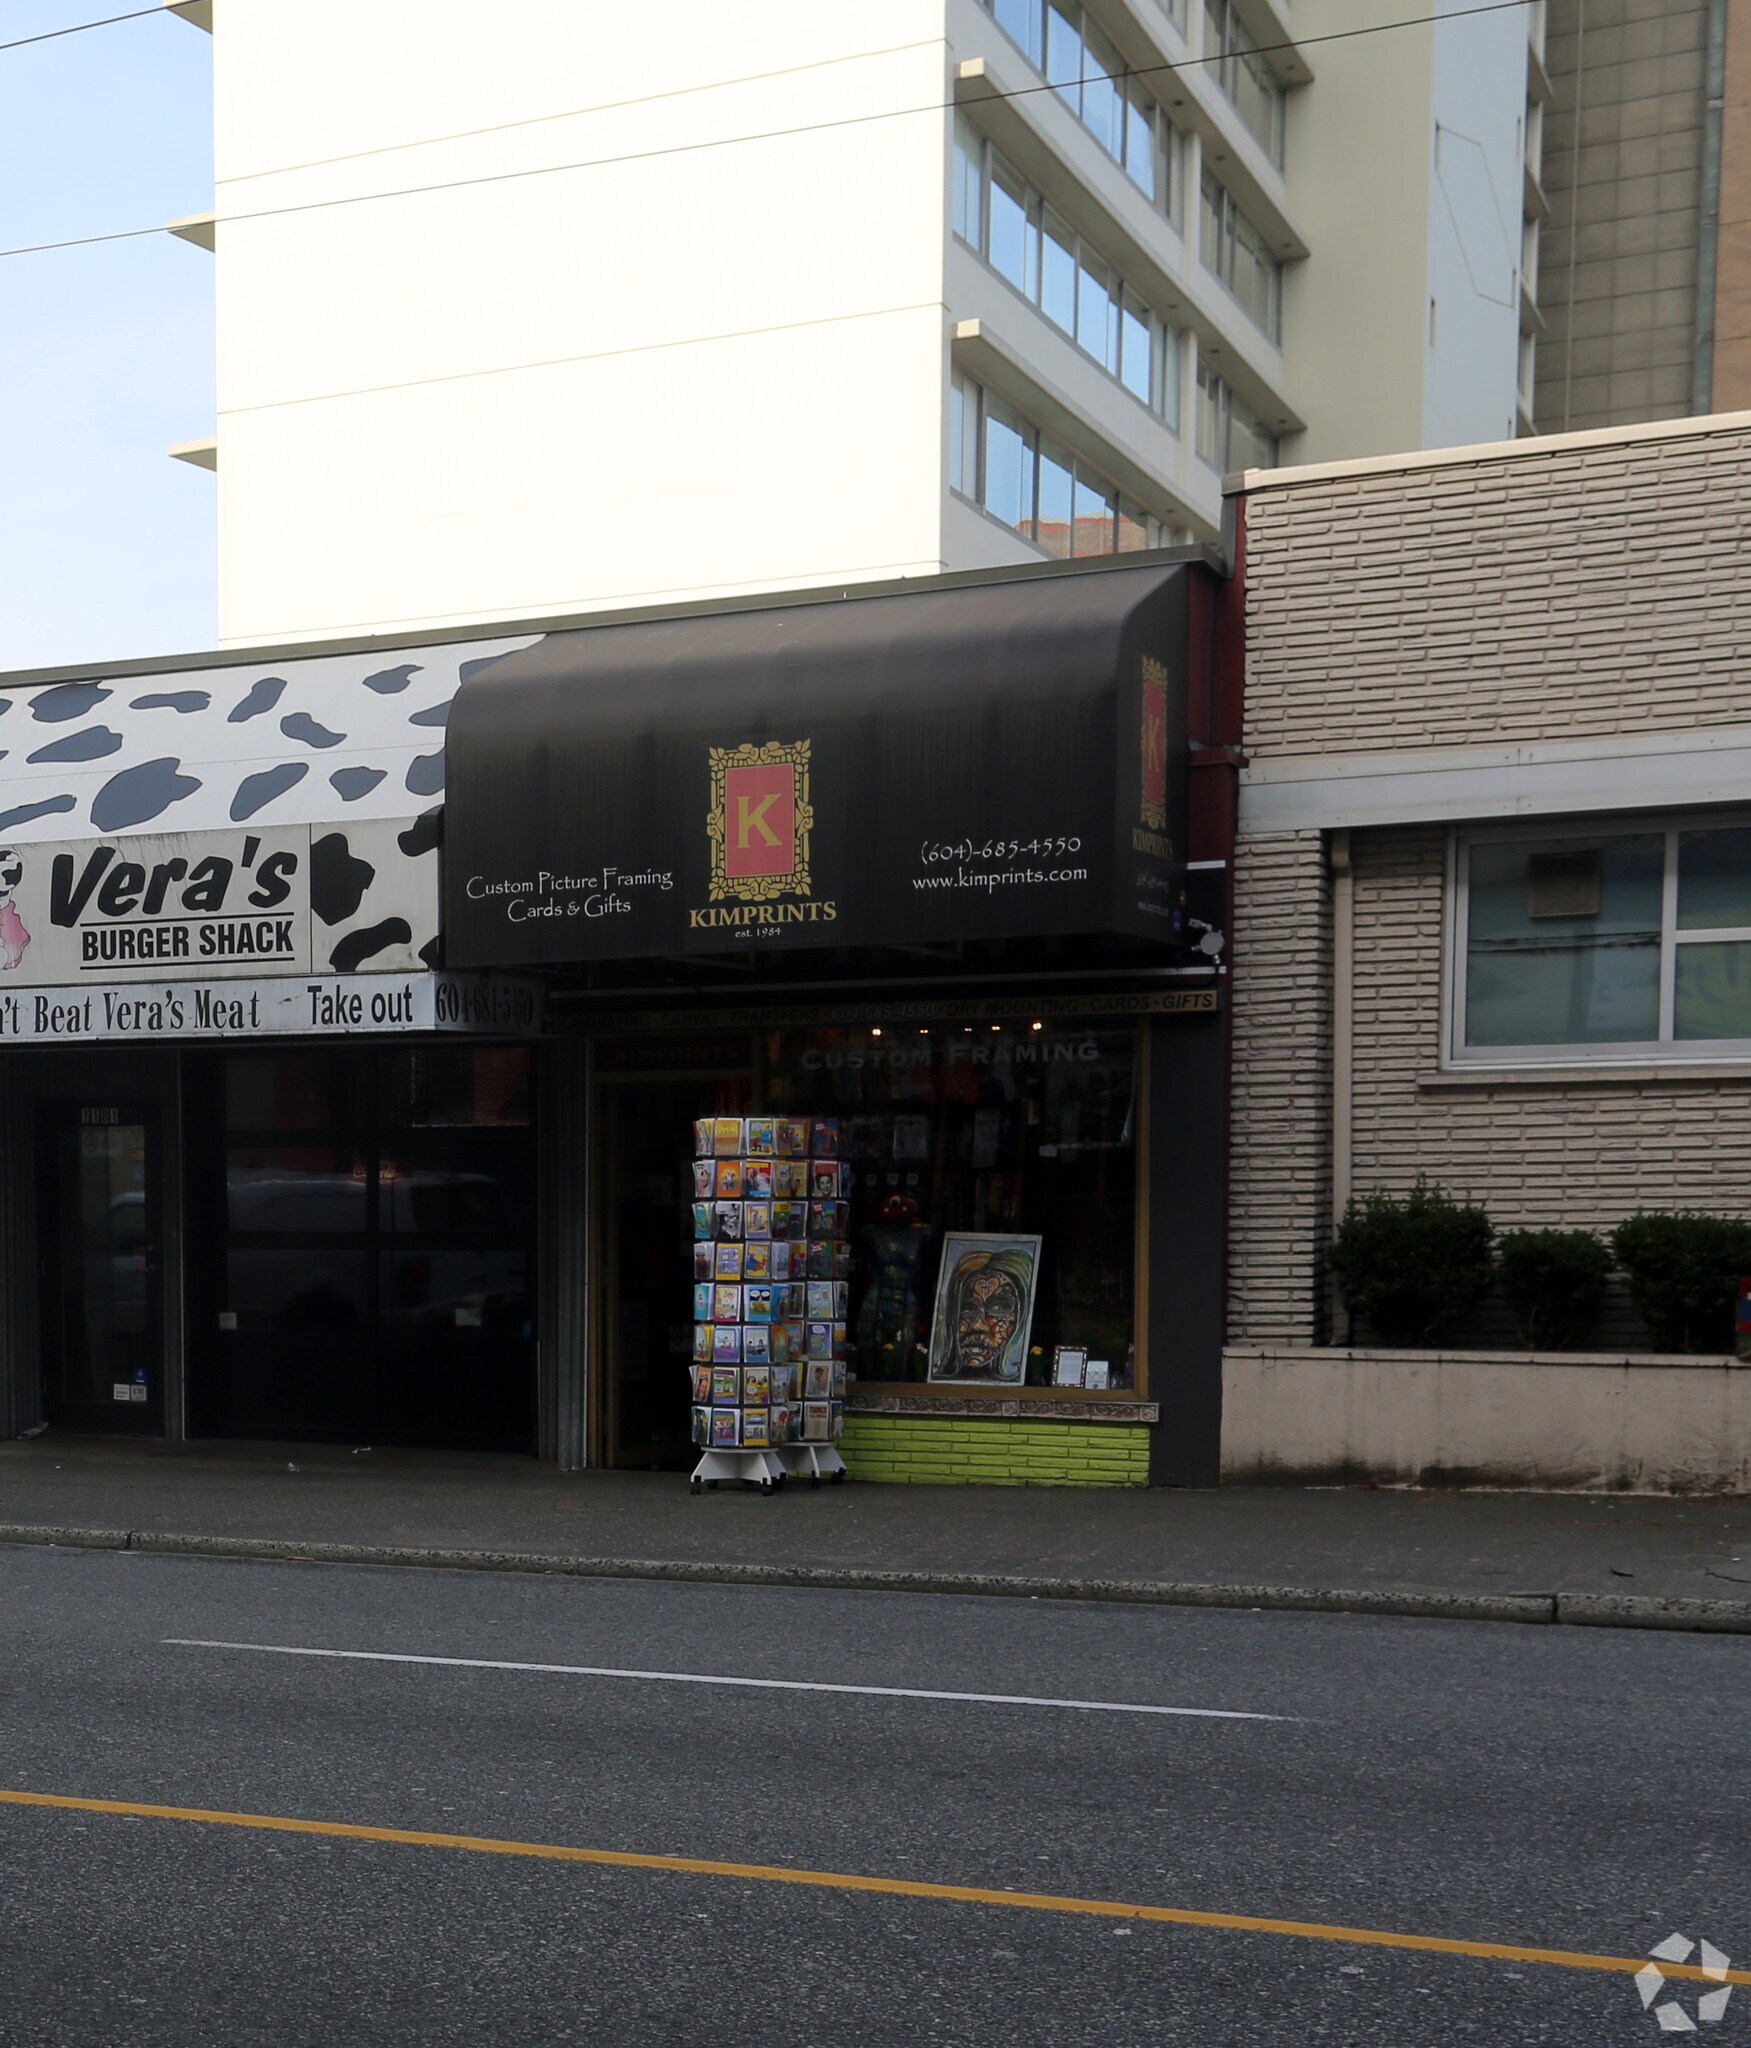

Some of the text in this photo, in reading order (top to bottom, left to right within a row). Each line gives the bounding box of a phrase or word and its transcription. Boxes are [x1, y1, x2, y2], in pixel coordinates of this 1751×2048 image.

[1148, 714, 1160, 773] K
[736, 793, 783, 849] K
[921, 837, 1081, 865] (604)-685-4550
[50, 835, 298, 928] Vera's
[466, 867, 674, 899] Custom Picture Framing
[912, 867, 1087, 895] www.kimprints.com
[507, 893, 631, 922] Cards & Gifts
[689, 901, 837, 928] KIMPRINTS
[82, 920, 294, 961] BURGER SHACK
[734, 926, 782, 938] est. 1984
[34, 996, 92, 1034] Beat
[103, 990, 185, 1031] Vera's
[194, 989, 261, 1029] Meat
[307, 983, 413, 1025] Take out
[661, 1011, 720, 1026] CANVAS
[731, 1007, 820, 1024] TRANSFERS
[832, 1004, 935, 1020] 604-685-4550
[947, 1001, 980, 1016] DRY
[985, 998, 1079, 1014] MOUNTING
[1090, 995, 1150, 1010] CARDS
[1162, 992, 1214, 1008] GIFTS
